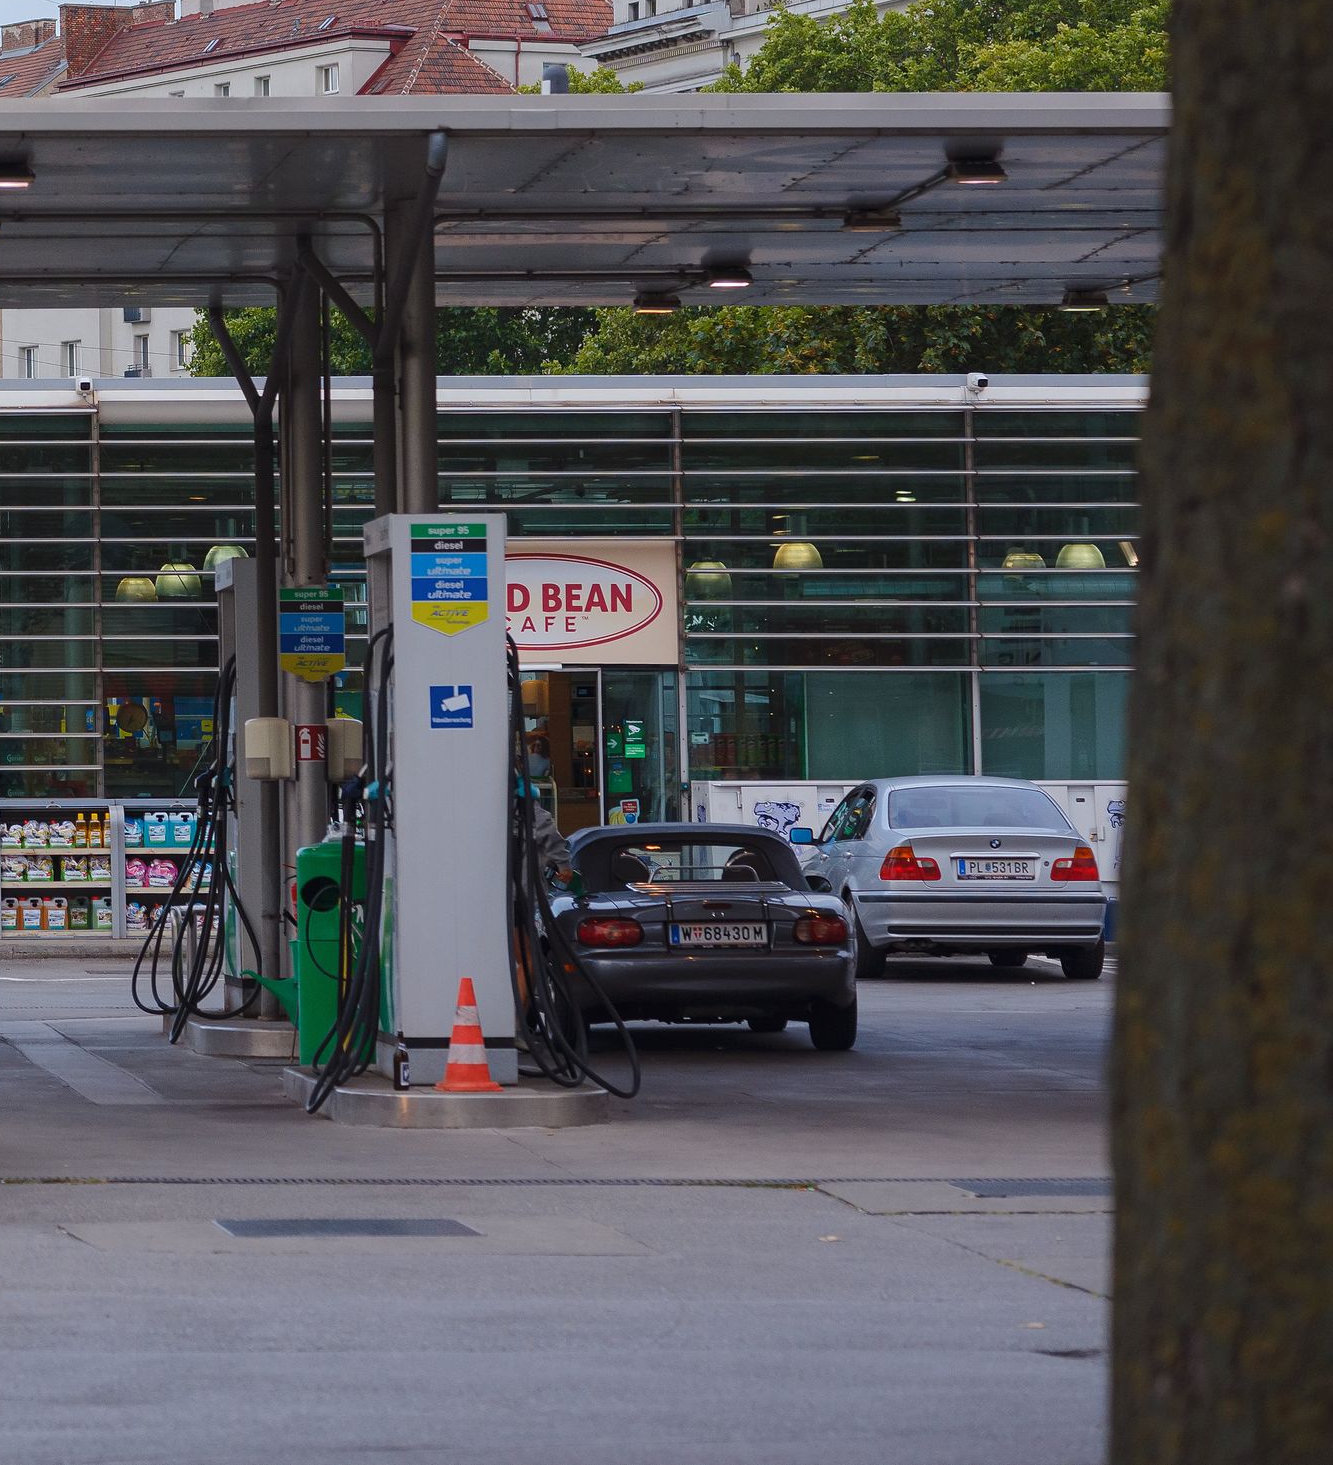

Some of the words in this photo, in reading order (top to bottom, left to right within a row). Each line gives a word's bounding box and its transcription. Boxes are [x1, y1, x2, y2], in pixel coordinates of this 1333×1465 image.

[428, 527, 455, 536] super
[457, 526, 470, 535] 95
[434, 541, 464, 550] diesel
[427, 567, 472, 576] ultimate
[435, 581, 464, 589] diesel
[294, 591, 318, 599] super
[319, 590, 329, 598] 95
[427, 591, 472, 599] ultimate
[542, 583, 633, 613] BEAN
[299, 603, 324, 611] diesel
[969, 862, 983, 874] PL
[681, 926, 692, 941] W
[753, 926, 763, 941] M
